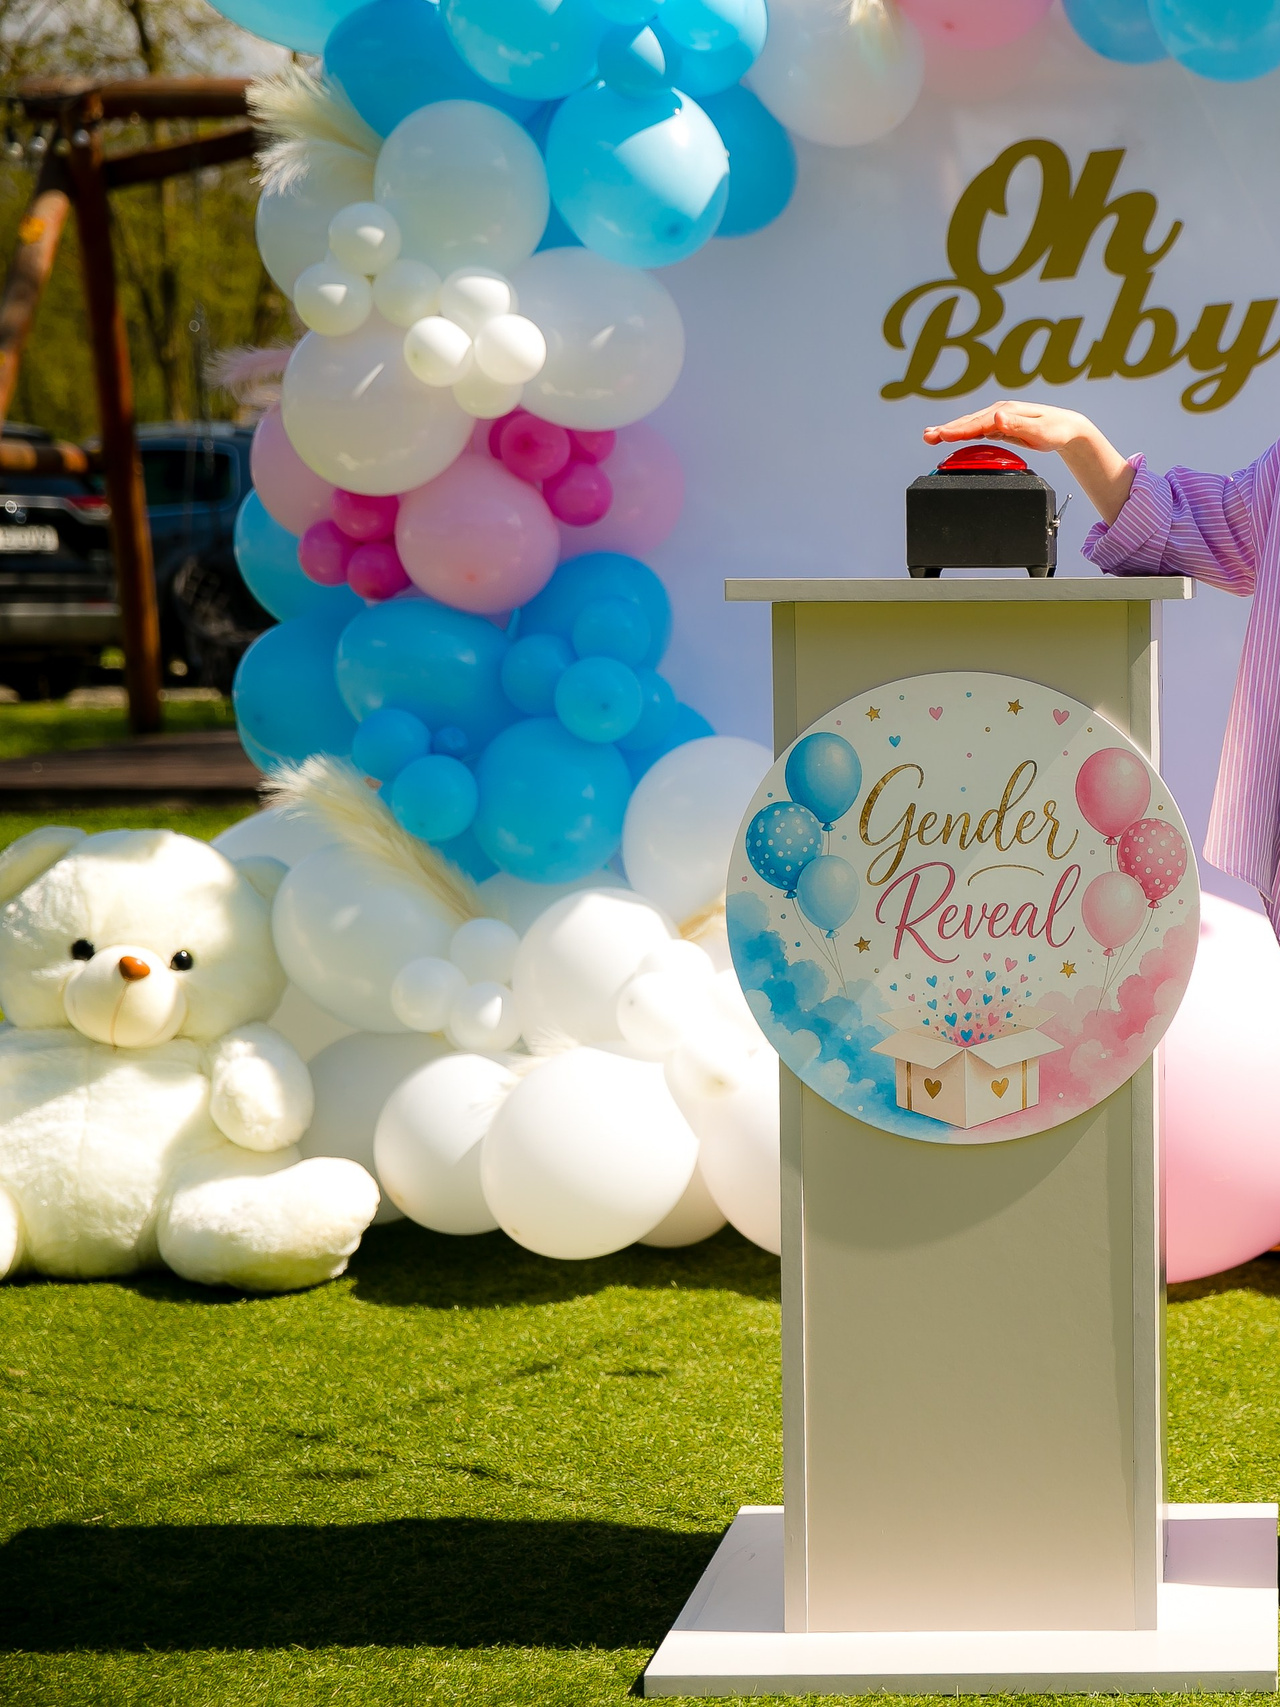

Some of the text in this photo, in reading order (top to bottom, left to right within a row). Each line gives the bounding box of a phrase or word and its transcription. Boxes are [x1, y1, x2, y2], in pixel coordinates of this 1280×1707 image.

[947, 139, 1184, 286] Oh
[859, 760, 1079, 887] Gender
[876, 862, 1082, 964] Reveal
